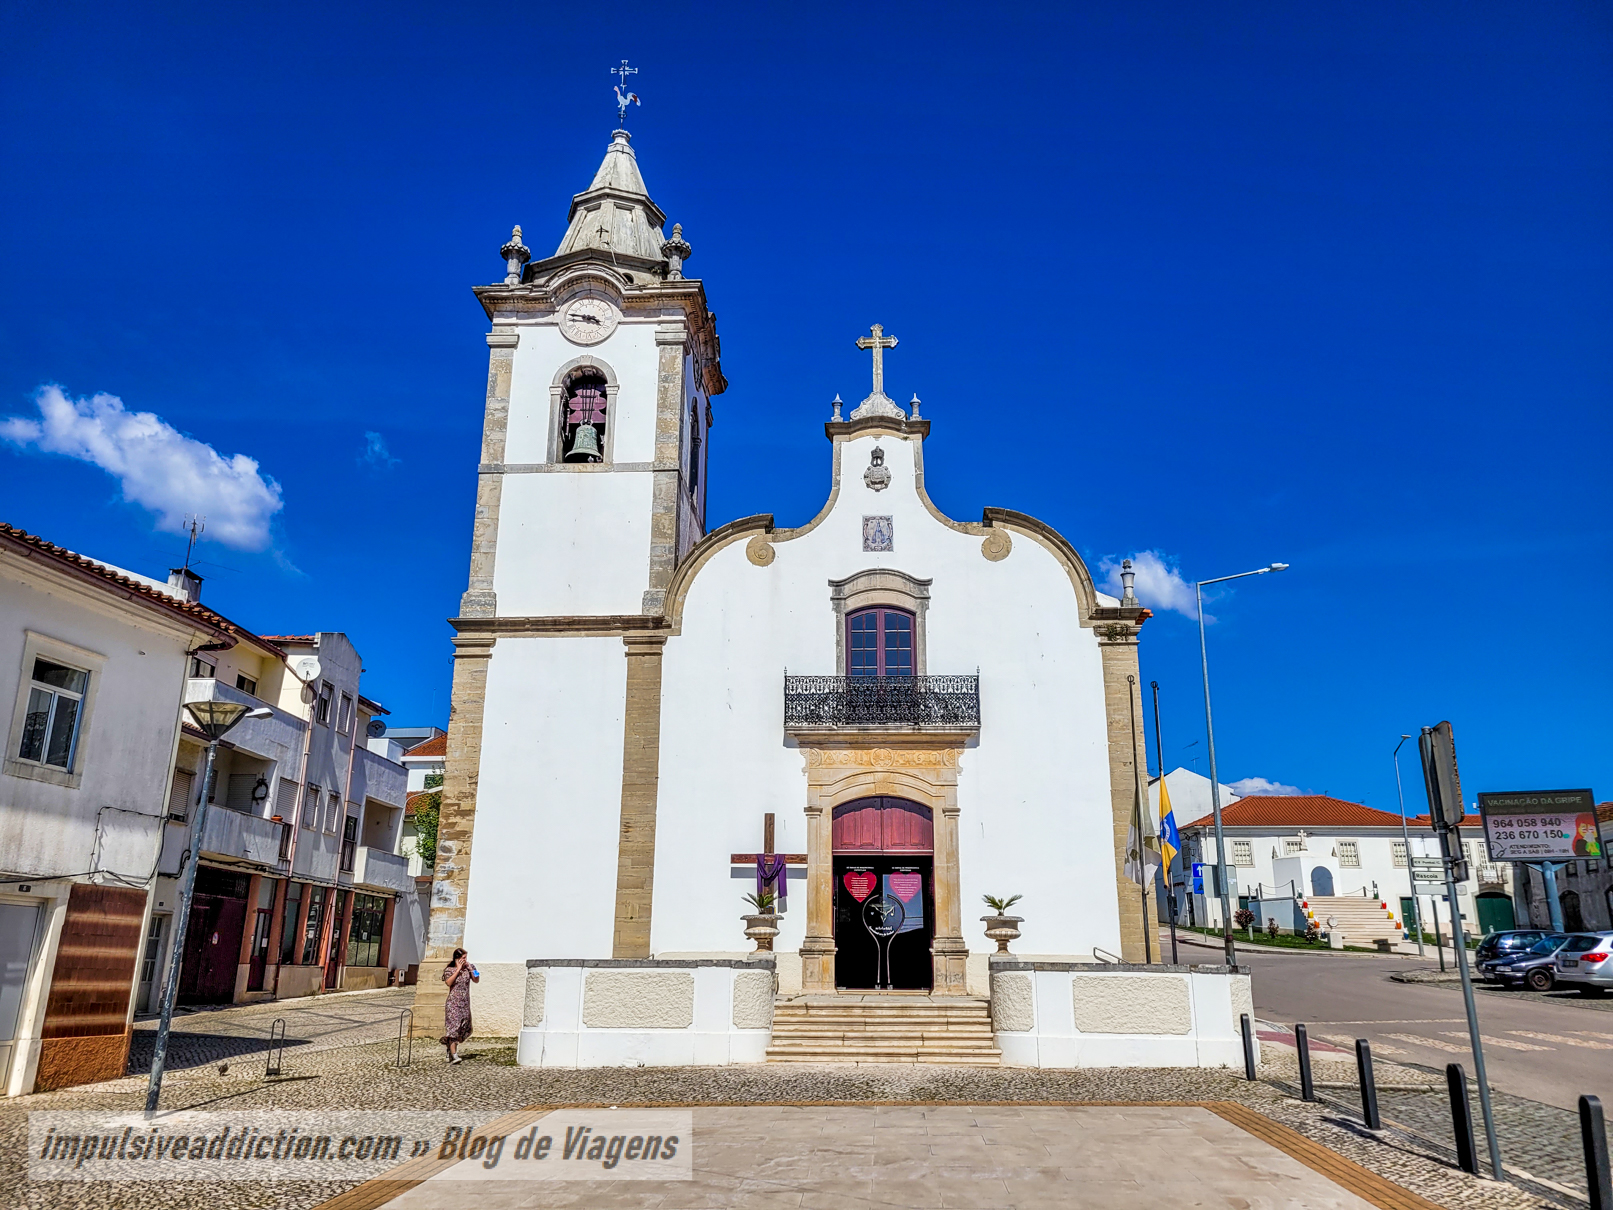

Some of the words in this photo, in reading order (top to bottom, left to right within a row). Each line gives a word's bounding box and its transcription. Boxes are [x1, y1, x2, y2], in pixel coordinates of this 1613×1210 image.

[1487, 797, 1539, 807] VACINAÇÃO
[1540, 797, 1554, 805] DA
[1554, 796, 1583, 804] GRIPE
[1493, 819, 1514, 828] 964
[1516, 818, 1538, 828] 058
[1540, 817, 1562, 827] 940
[1495, 830, 1516, 840] 236
[1518, 830, 1539, 839] 670
[1542, 829, 1564, 839] 150
